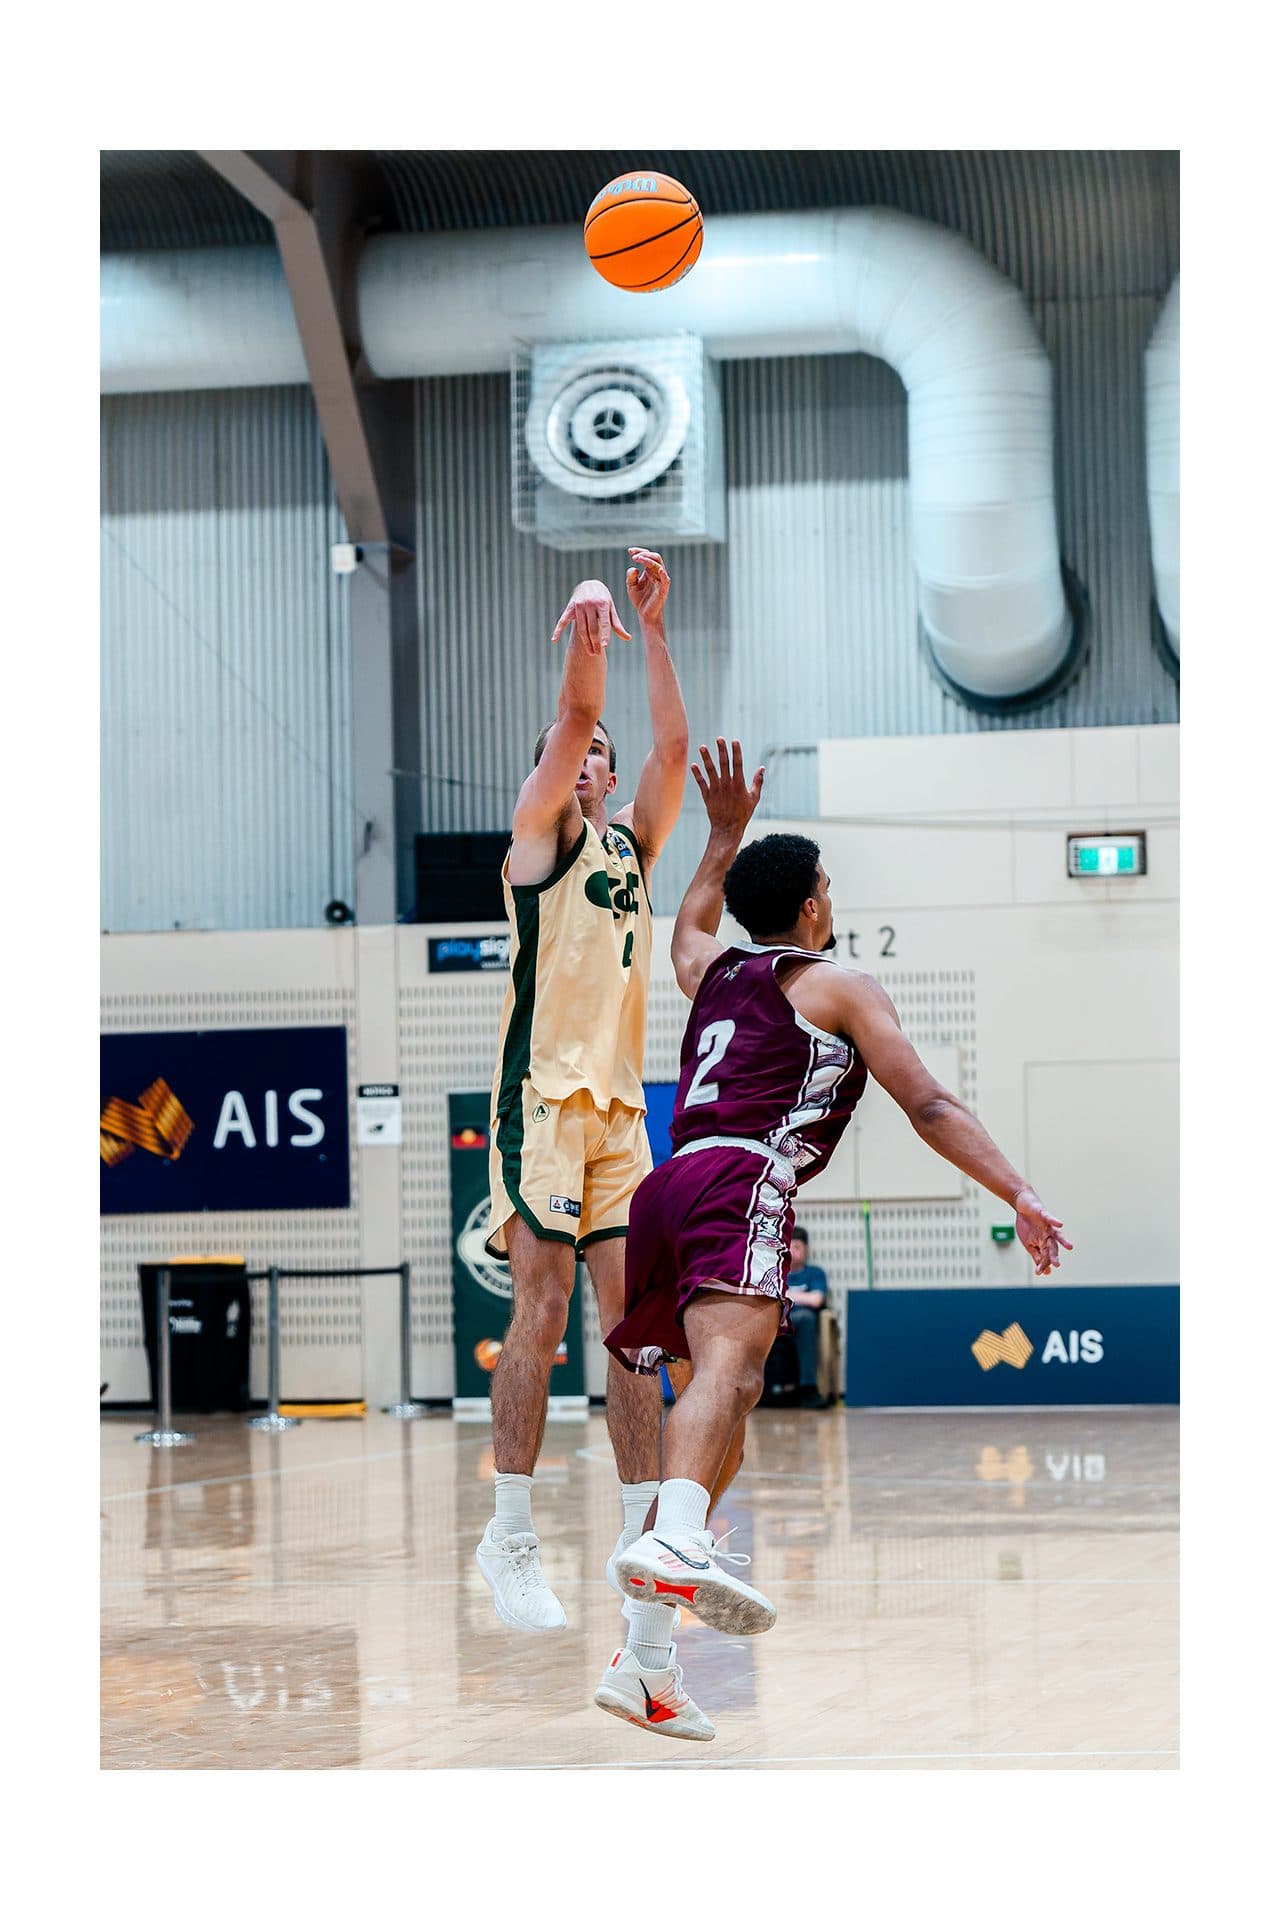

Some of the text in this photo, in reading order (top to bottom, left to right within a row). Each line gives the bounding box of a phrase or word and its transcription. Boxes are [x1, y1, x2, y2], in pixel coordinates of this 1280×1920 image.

[879, 925, 896, 958] 2
[683, 1018, 737, 1111] 2
[212, 1088, 326, 1149] AIS
[1041, 1329, 1104, 1364] AIS
